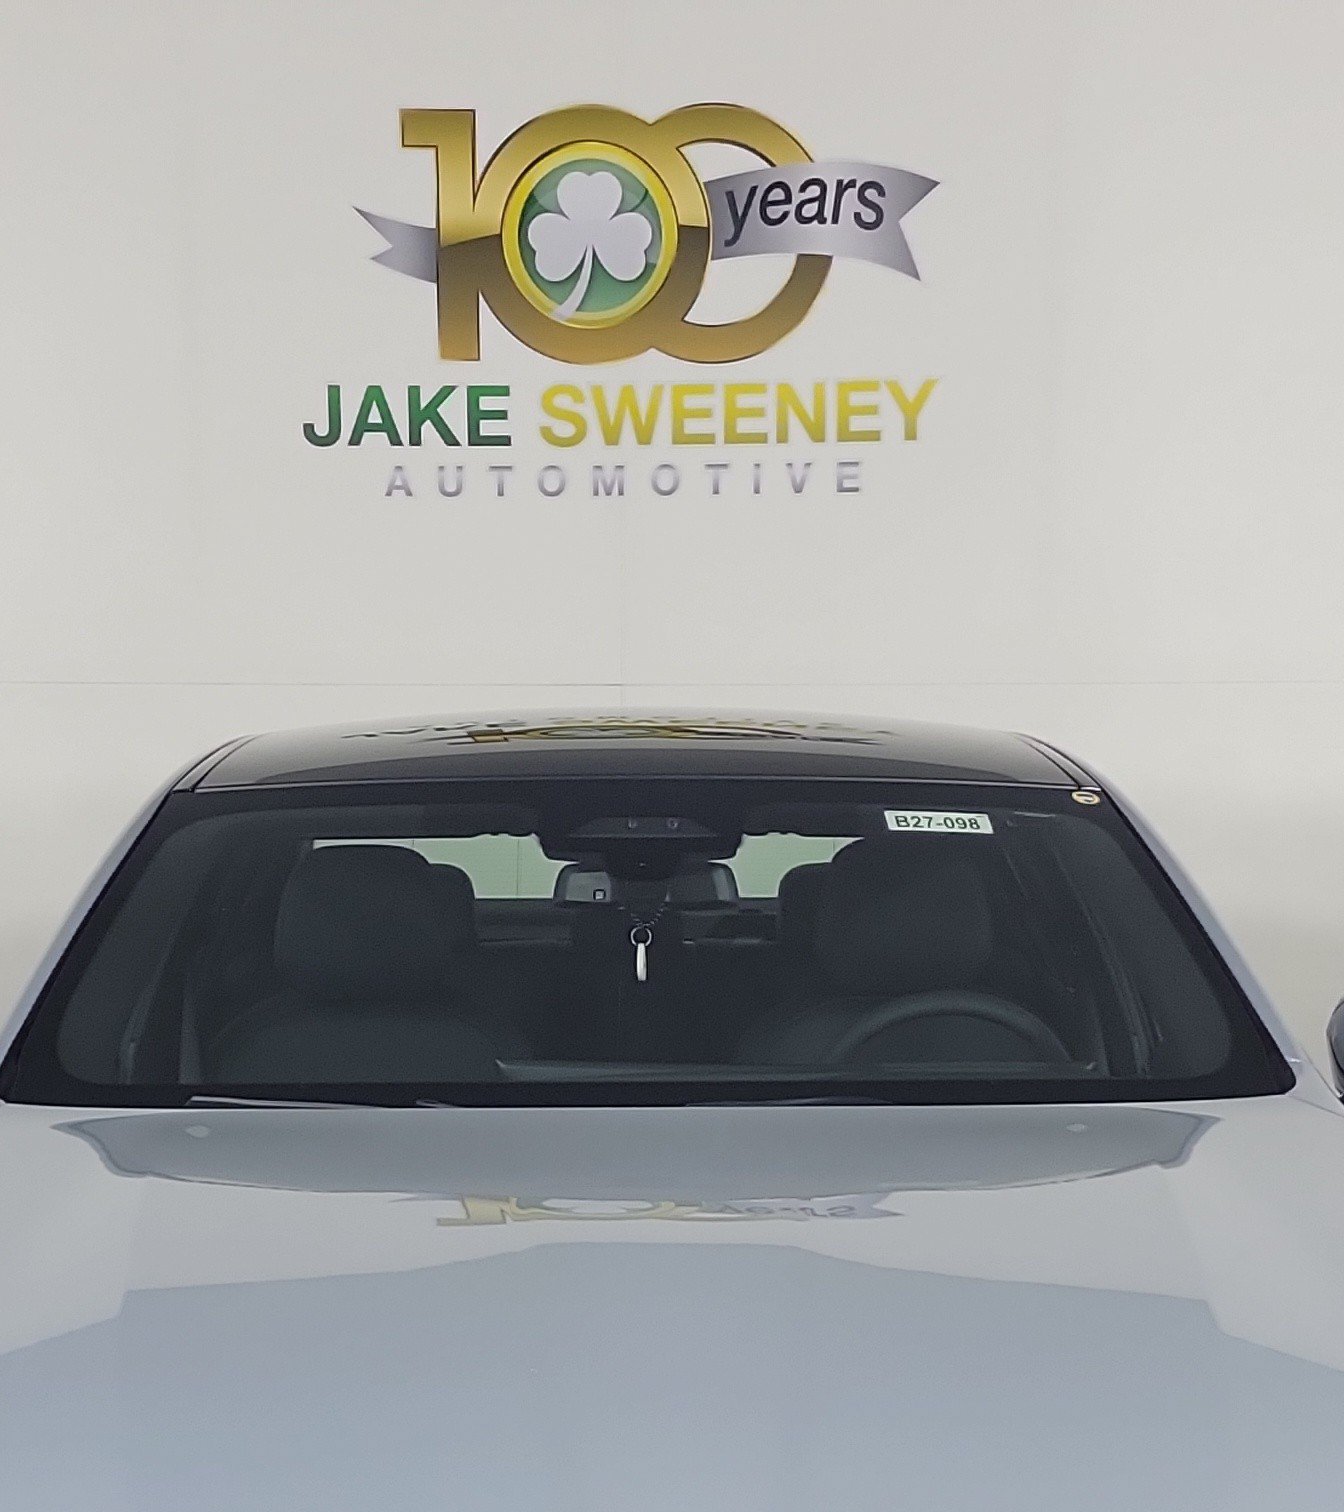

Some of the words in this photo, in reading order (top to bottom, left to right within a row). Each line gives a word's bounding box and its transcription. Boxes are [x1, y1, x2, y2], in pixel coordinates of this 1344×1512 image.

[399, 103, 834, 364] 100
[723, 176, 887, 246] years
[302, 383, 513, 447] JAKE
[539, 377, 940, 447] SWEENEY
[384, 460, 863, 498] AUTOMOTIVE
[894, 815, 981, 830] B27-098
